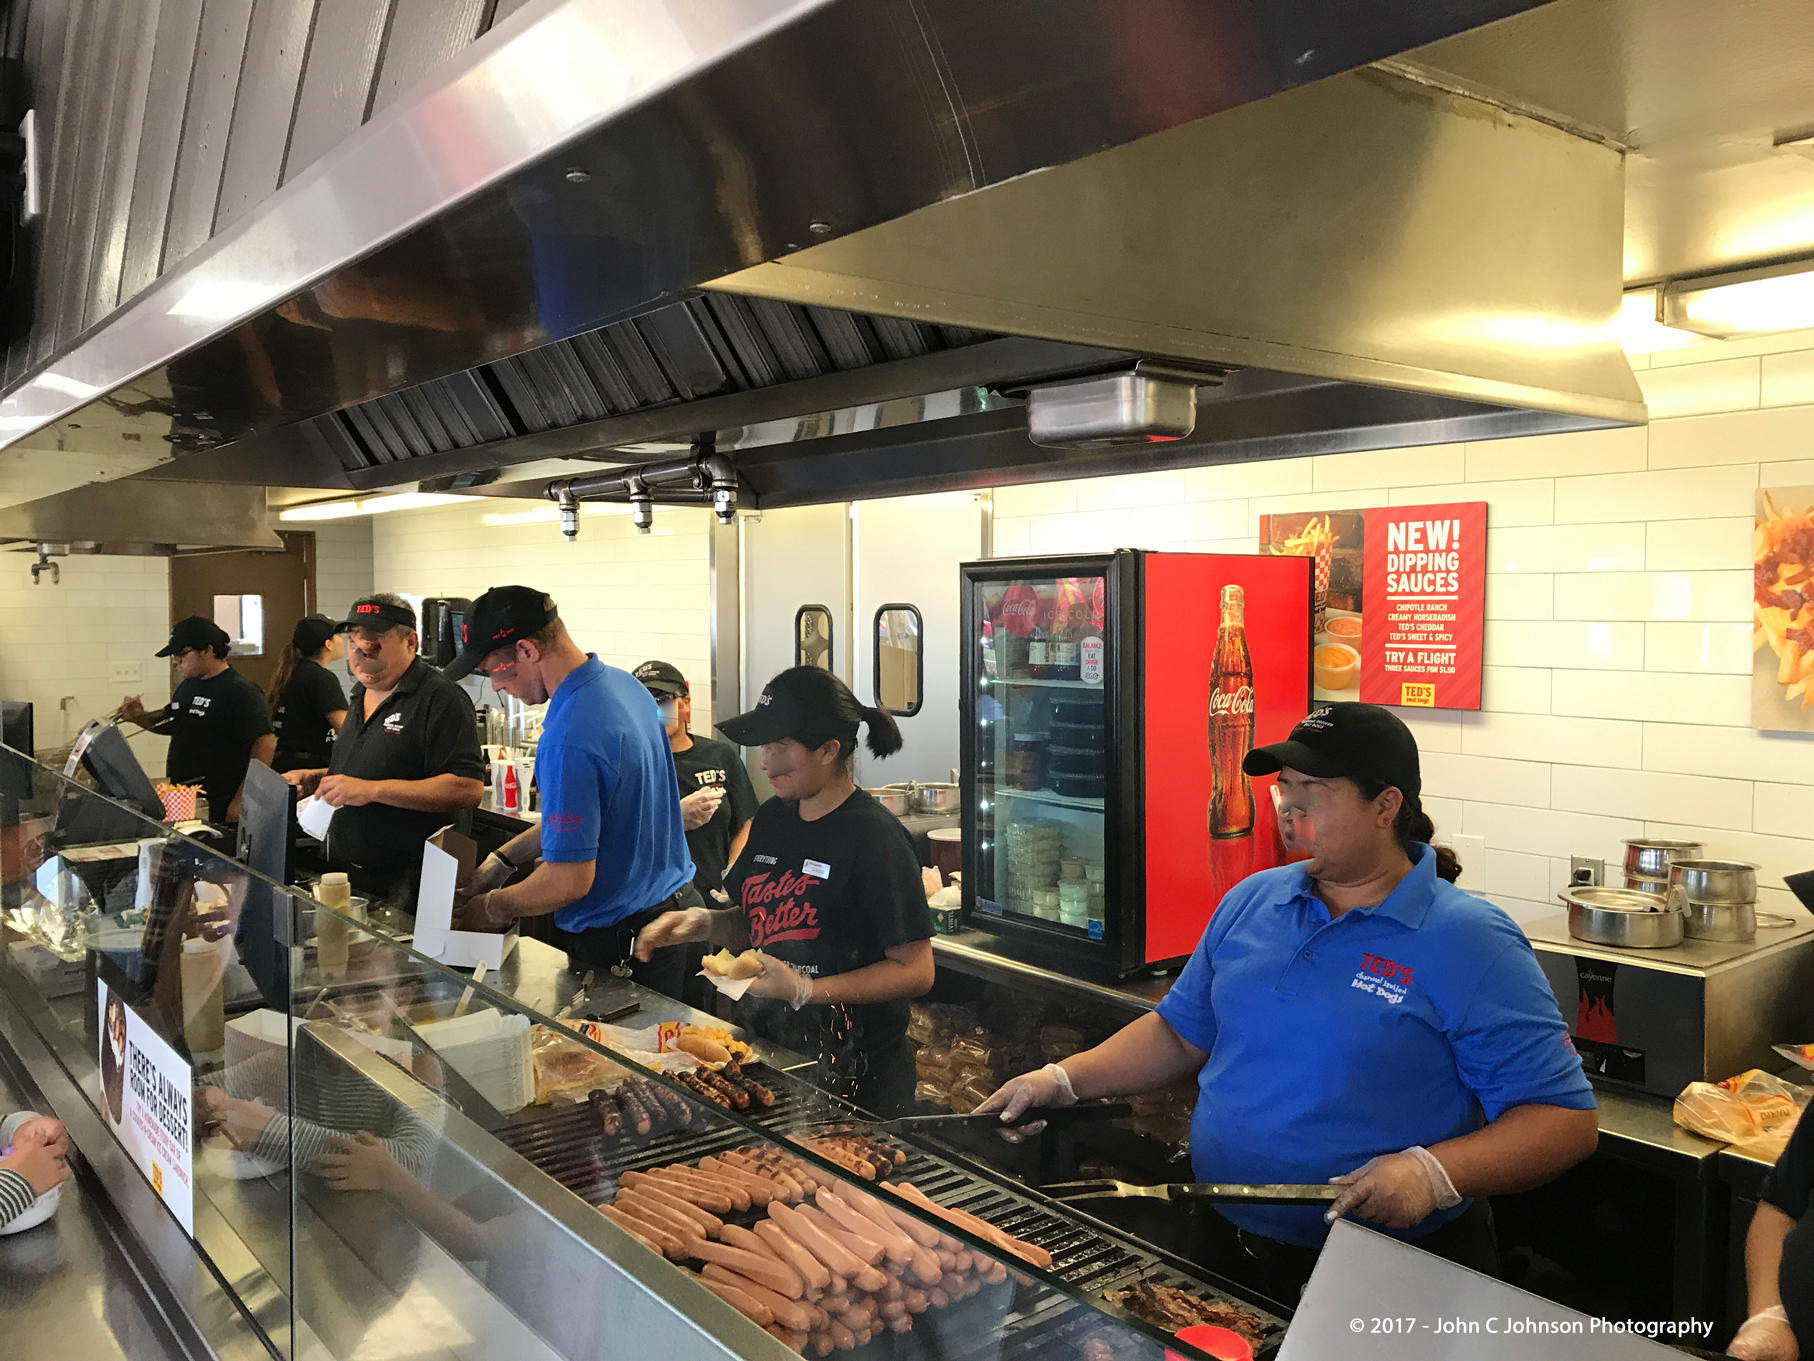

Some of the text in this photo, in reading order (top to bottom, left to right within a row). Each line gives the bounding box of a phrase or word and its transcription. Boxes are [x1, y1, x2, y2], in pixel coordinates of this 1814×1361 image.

[1387, 519, 1460, 552] NEW!
[1387, 551, 1460, 573] DIPPING
[1386, 572, 1459, 593] SAUCES
[356, 603, 380, 614] TED'S
[1396, 603, 1447, 612] CHIPOTLE RANCH
[1387, 613, 1456, 621] CREAMY HORSERADISH
[1398, 623, 1445, 631] TED'S CHEDDAR
[1389, 632, 1453, 641] TED'S SWEET & SPICY
[1384, 651, 1456, 665] TRY A FLIGHT
[1384, 664, 1403, 672] THREE
[1403, 665, 1426, 673] SAUCES
[1439, 666, 1456, 674] $1.50
[1405, 686, 1432, 697] TED'S
[192, 696, 212, 708] TED'S
[1209, 685, 1254, 717] Coca-Cola
[694, 769, 727, 785] TED'S
[741, 869, 820, 915] Tastes
[748, 897, 819, 948] Better
[1361, 952, 1415, 986] TED'S
[1580, 970, 1613, 983] cayenne
[1351, 979, 1404, 1005] Hot Dogs
[129, 1039, 157, 1092] THERE'S
[158, 1071, 188, 1126] ALWAYS
[130, 1067, 189, 1154] ROOM FOR DESSERT!
